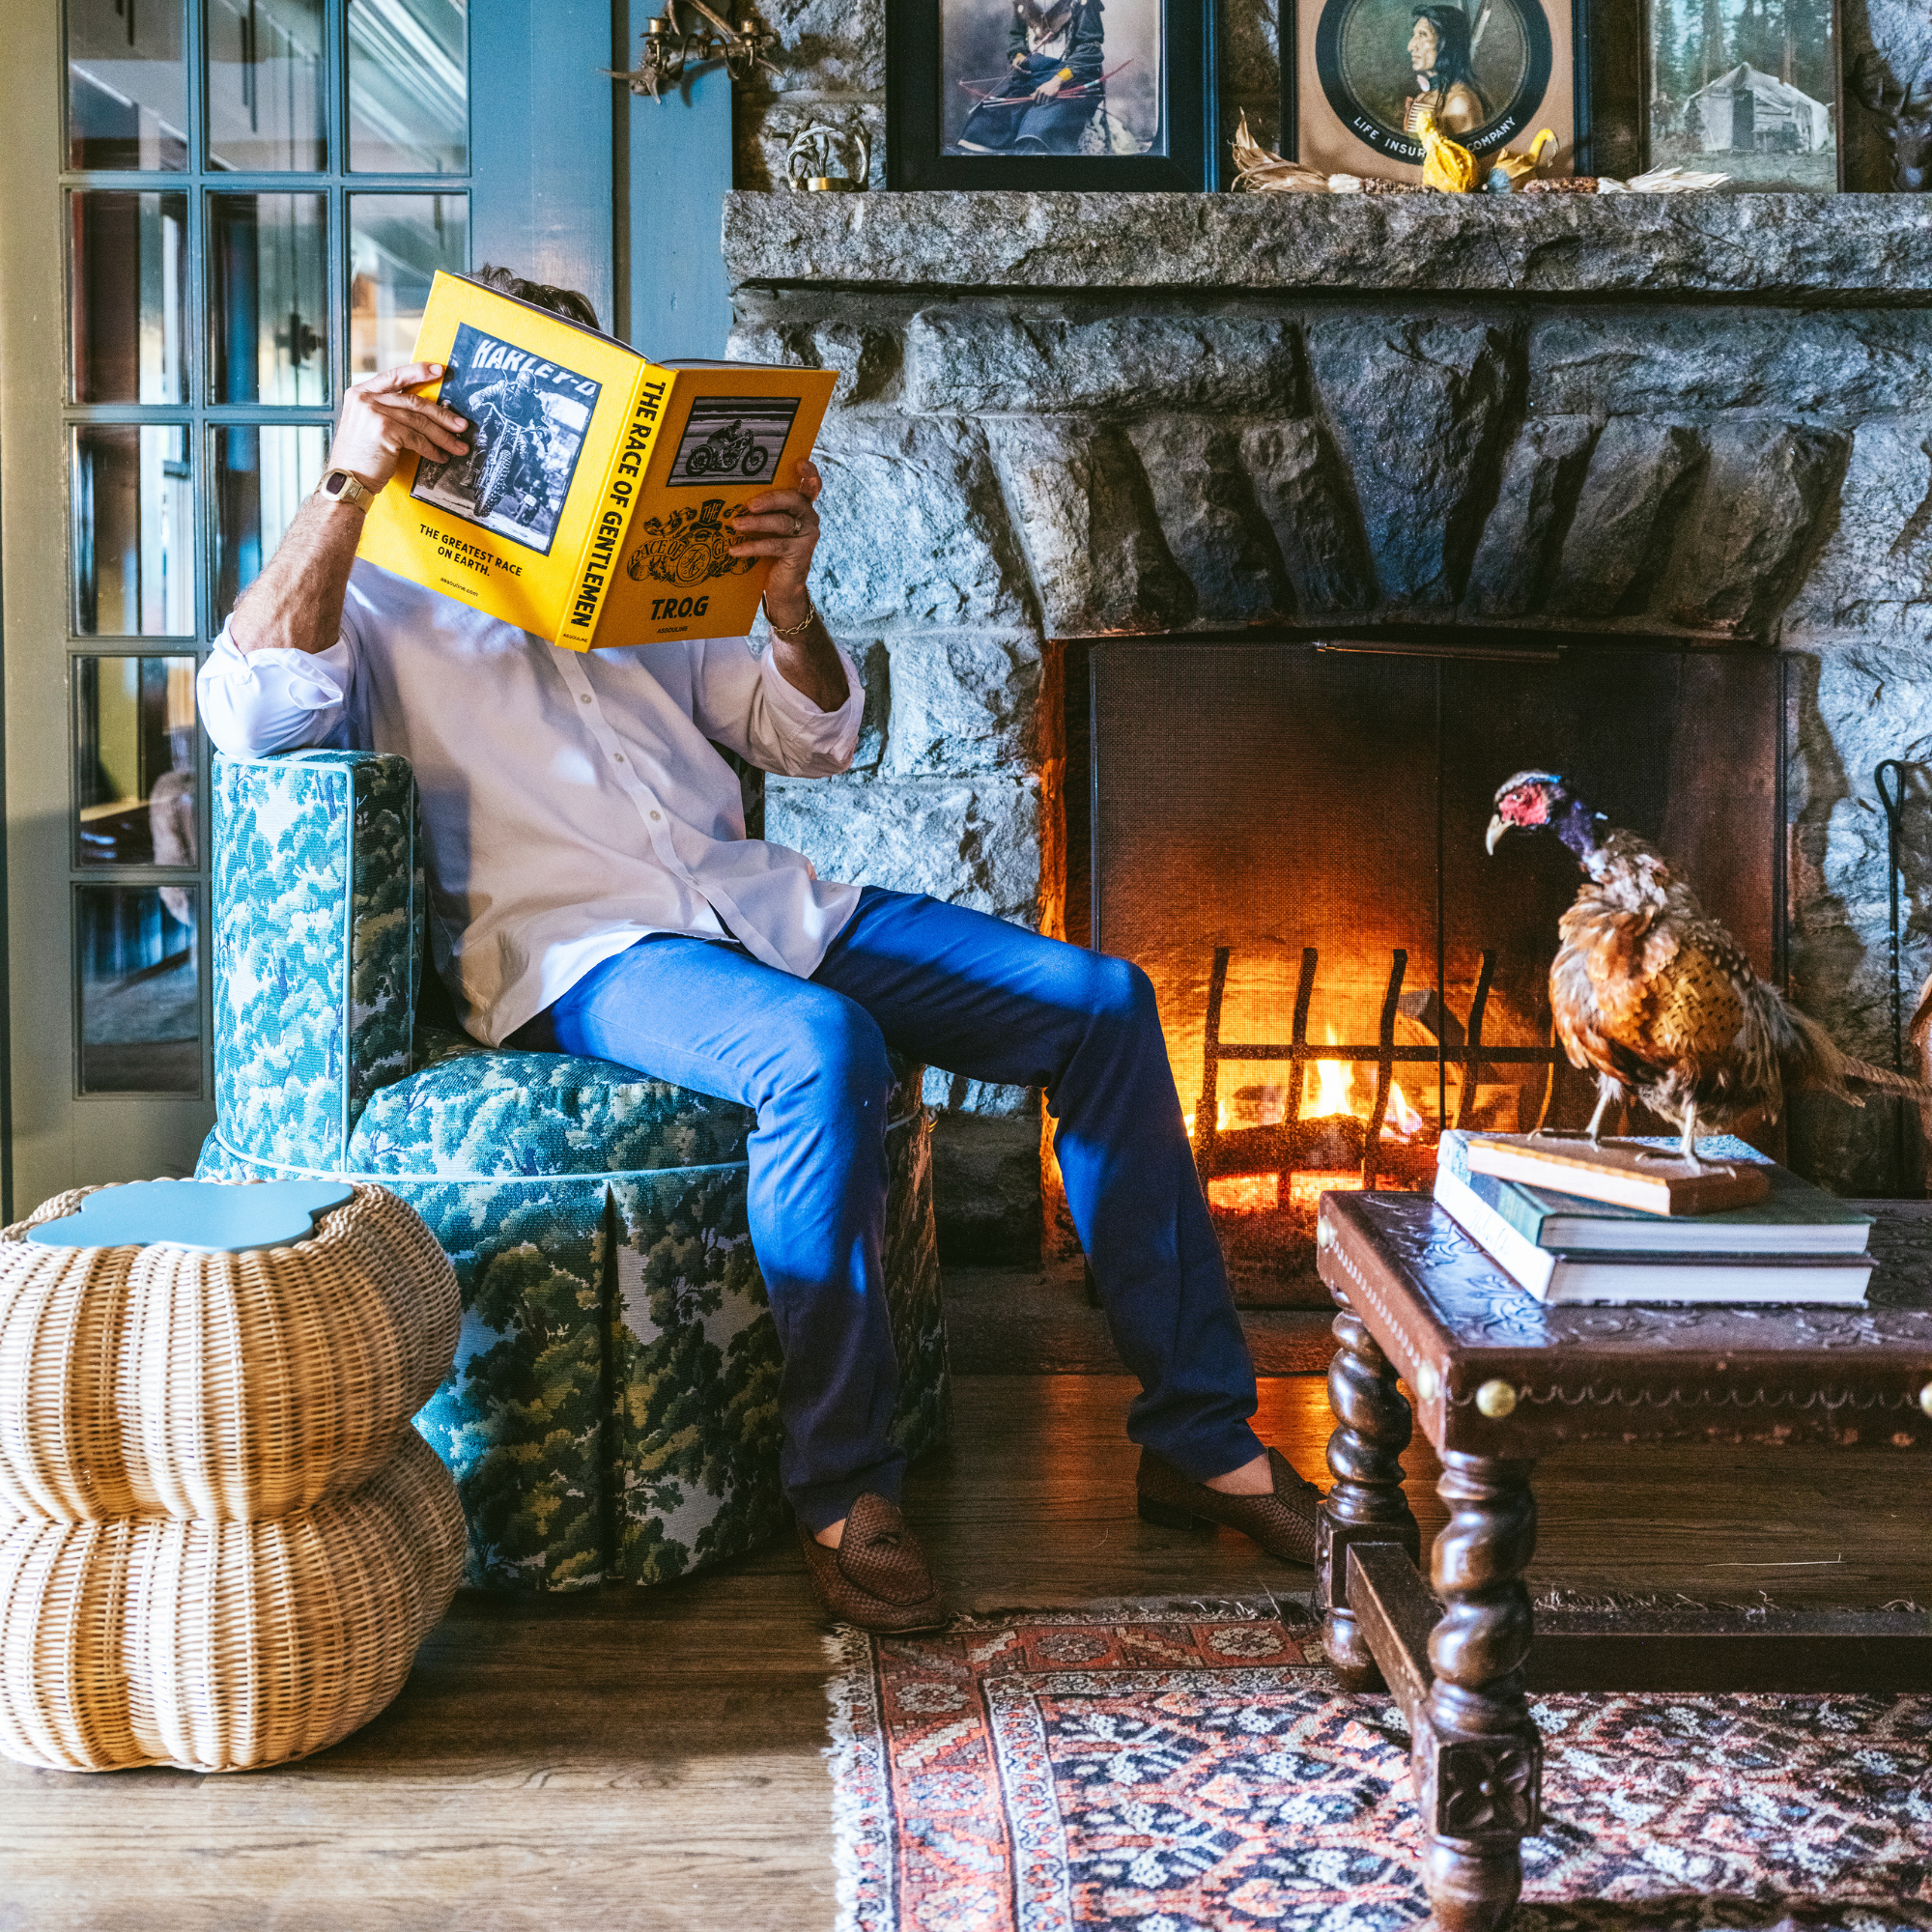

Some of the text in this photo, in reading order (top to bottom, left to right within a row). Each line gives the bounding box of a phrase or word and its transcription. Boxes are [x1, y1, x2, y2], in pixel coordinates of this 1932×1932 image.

[1353, 116, 1516, 157] LIFE INSUR COMPANY
[570, 381, 667, 628] THE RACE OF GENTLEMEN
[702, 502, 722, 522] THE
[420, 524, 523, 577] THE GREATEST RACE
[438, 547, 490, 577] ON EARTH.
[631, 540, 668, 565] RACE
[668, 541, 686, 560] OF
[440, 578, 479, 597] assouline.com
[651, 596, 709, 620] T.R.O.G
